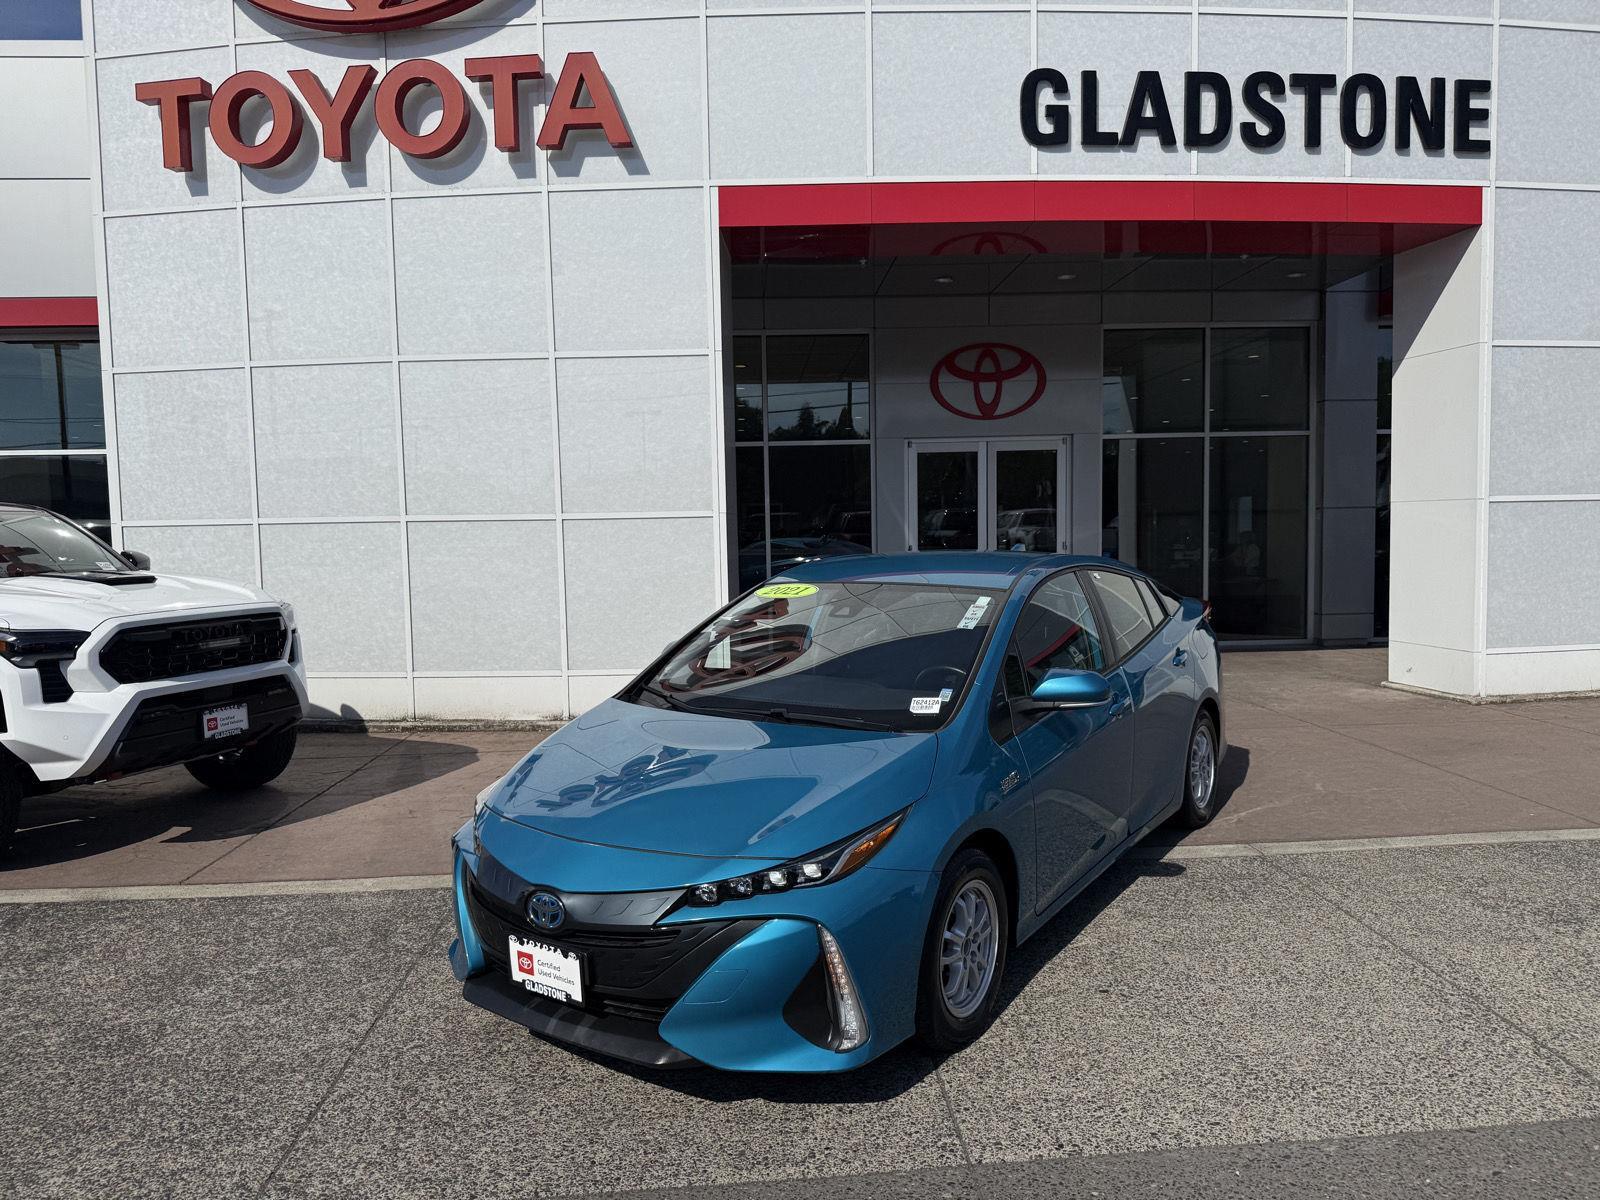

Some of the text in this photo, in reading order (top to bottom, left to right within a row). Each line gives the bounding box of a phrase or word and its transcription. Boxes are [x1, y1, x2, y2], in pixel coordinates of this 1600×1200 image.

[135, 51, 634, 173] TOYOTA
[1020, 68, 1491, 152] GLADSTONE
[762, 586, 811, 596] 2021
[182, 623, 244, 642] TOYOTA
[522, 937, 562, 955] TOYOTA
[537, 959, 561, 972] Certified
[538, 968, 575, 985] Used Vehicles
[525, 980, 567, 1002] GLADSTONE
